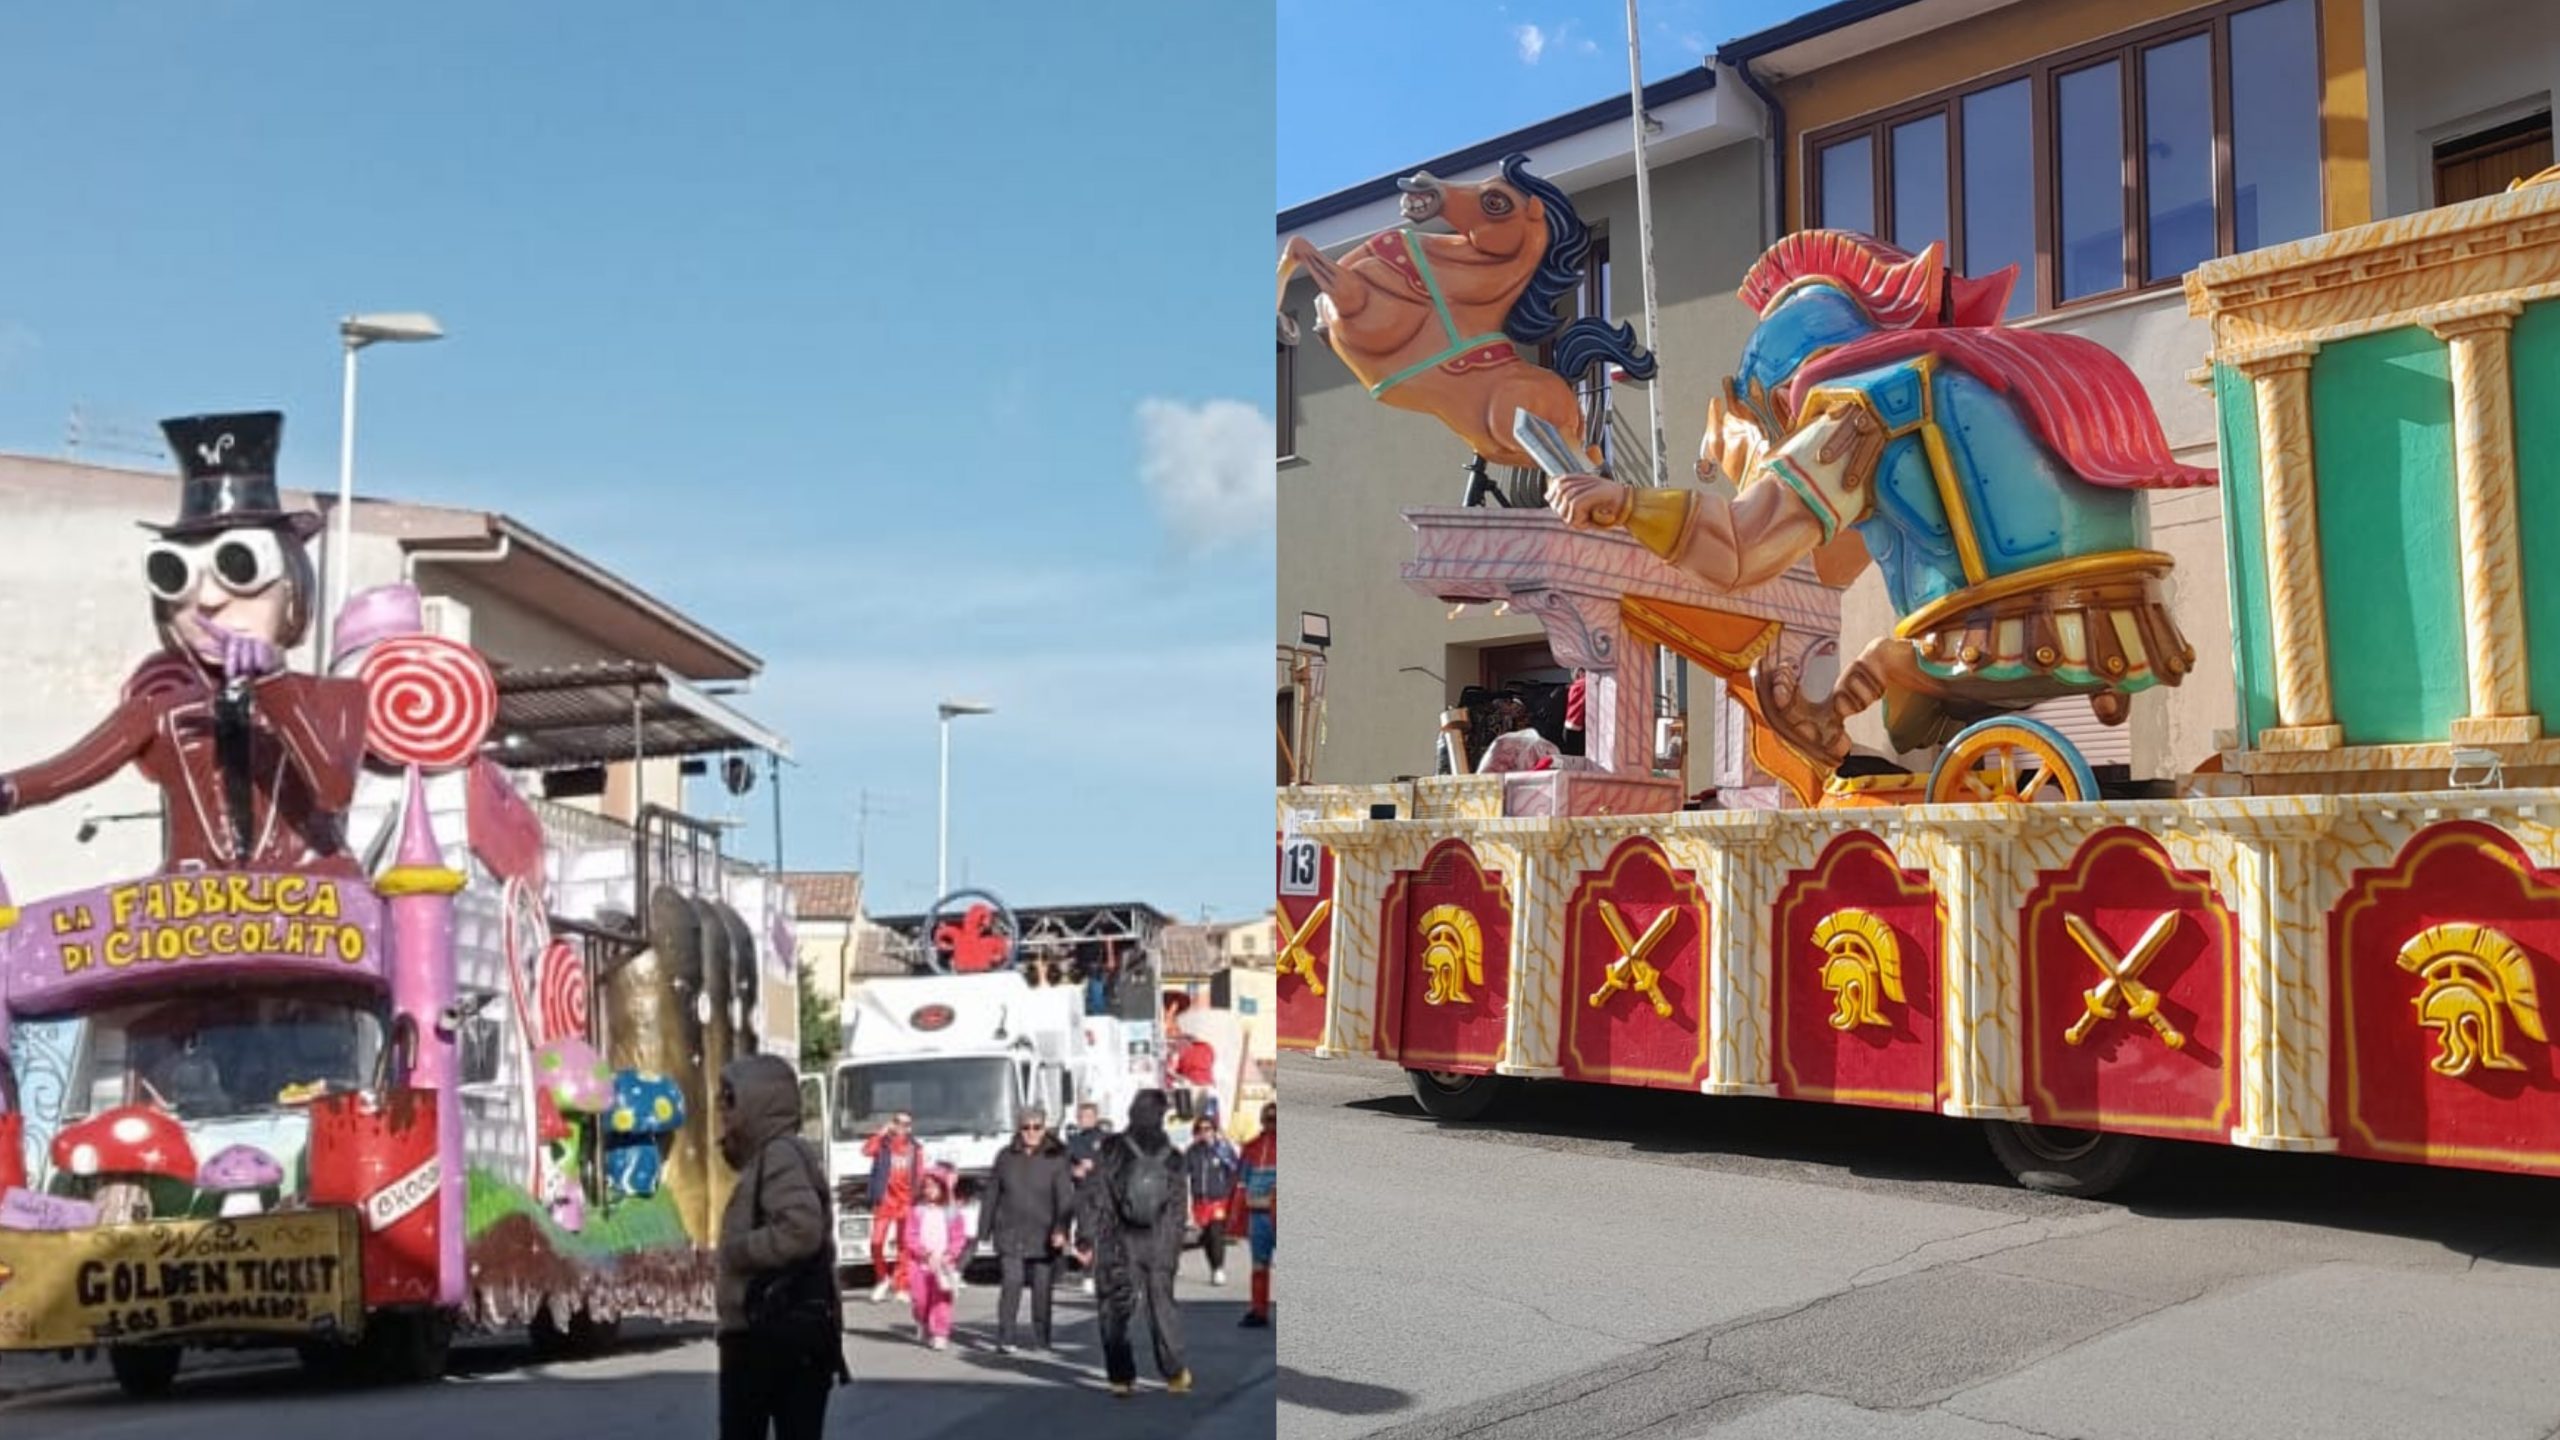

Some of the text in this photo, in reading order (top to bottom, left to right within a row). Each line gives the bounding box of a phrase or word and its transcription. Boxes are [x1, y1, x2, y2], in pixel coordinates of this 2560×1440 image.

[1288, 843, 1315, 885] 13
[52, 876, 341, 934] LA FABBRICA
[61, 920, 364, 974] DI CIOCCOLATO
[76, 1254, 337, 1306] GOLDEN TICKET
